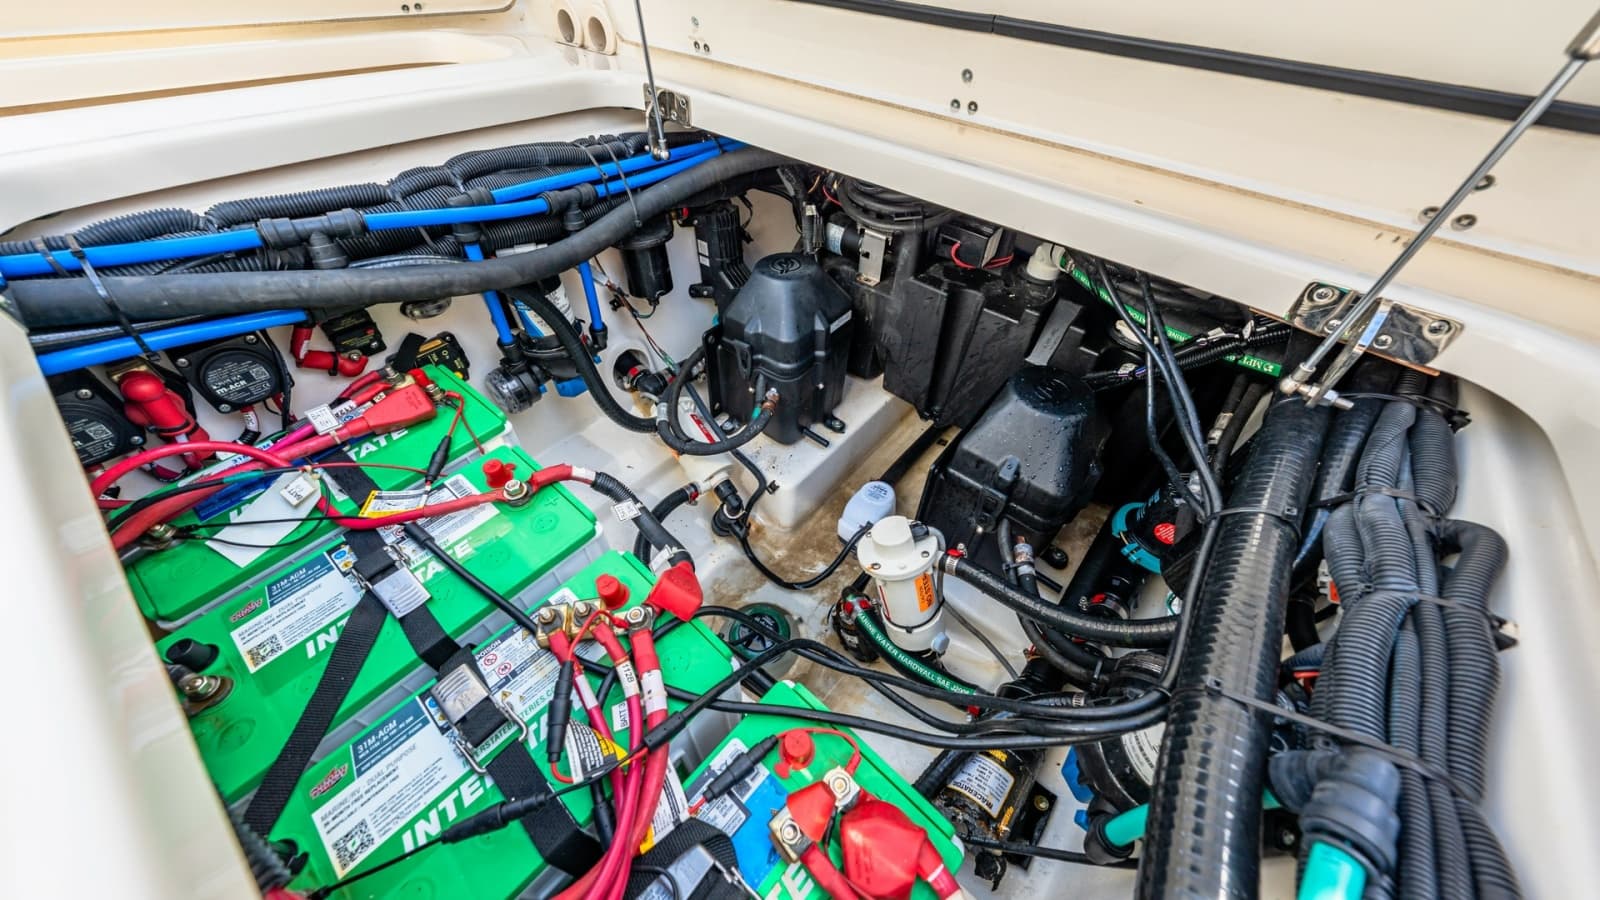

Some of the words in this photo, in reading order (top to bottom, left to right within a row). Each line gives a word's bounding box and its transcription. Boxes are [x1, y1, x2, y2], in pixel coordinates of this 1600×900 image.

[474, 638, 501, 661] POISON
[874, 632, 899, 656] WATER
[897, 653, 937, 681] HARDWALL
[937, 677, 951, 688] SAE
[622, 663, 634, 682] 112B
[356, 719, 398, 753] 31M-AGM
